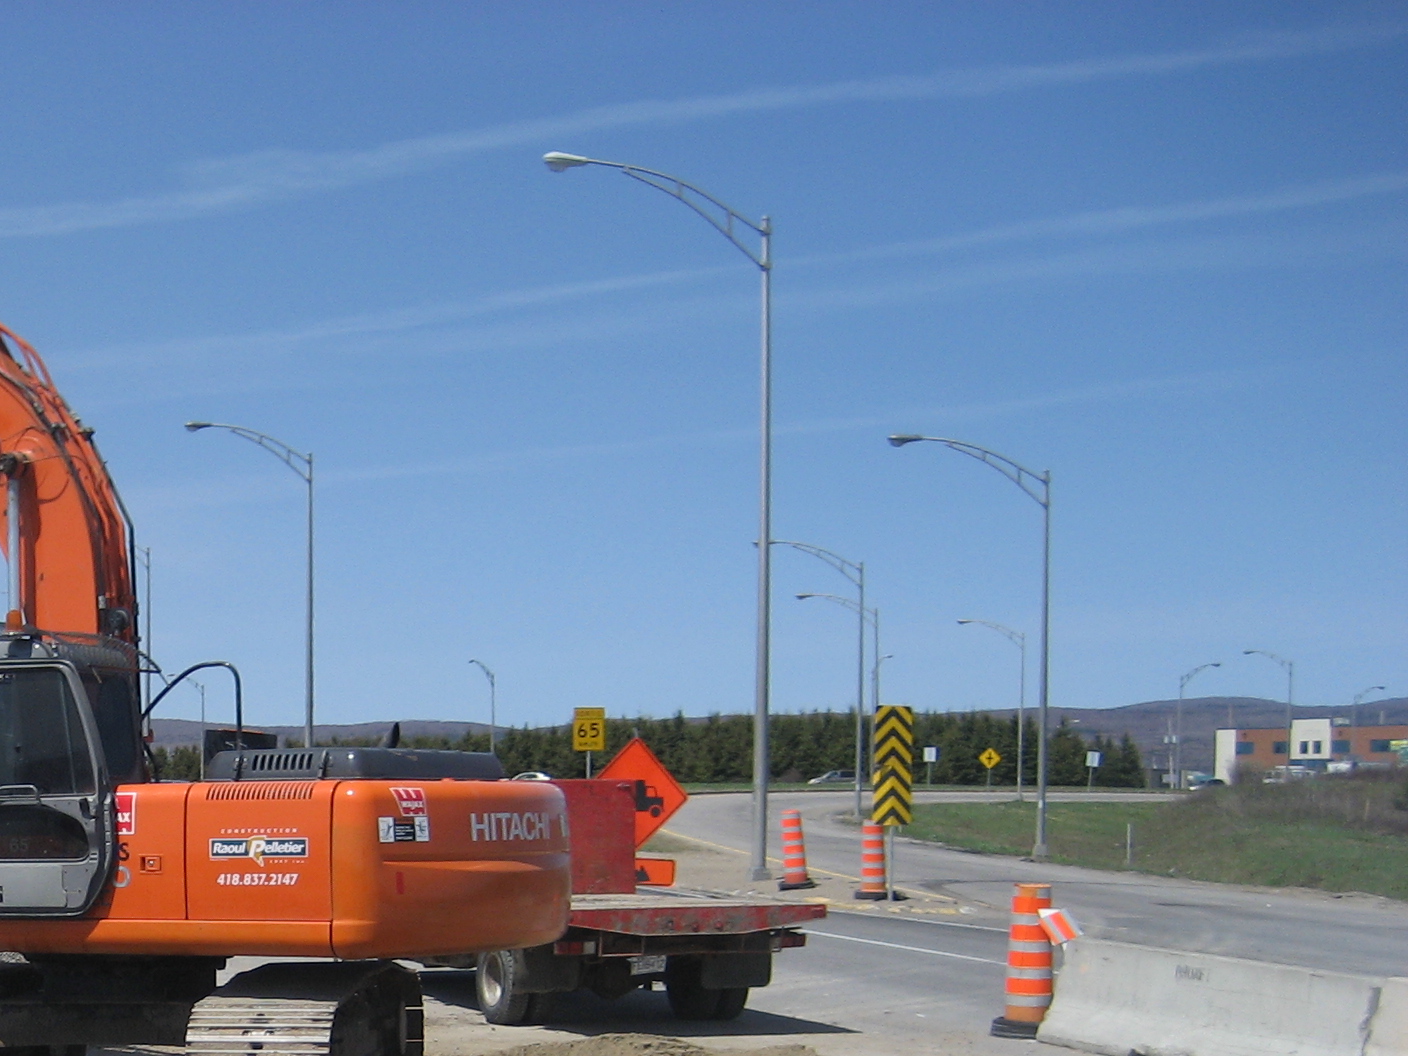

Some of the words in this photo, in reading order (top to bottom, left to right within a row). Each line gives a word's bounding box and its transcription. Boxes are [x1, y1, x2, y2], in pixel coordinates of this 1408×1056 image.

[577, 722, 600, 738] 65
[219, 827, 298, 835] CONSTRUCTION
[470, 811, 551, 842] HITACHI
[212, 842, 247, 854] Raoul
[248, 839, 305, 858] Pelletier
[216, 873, 299, 887] 418.837.2147
